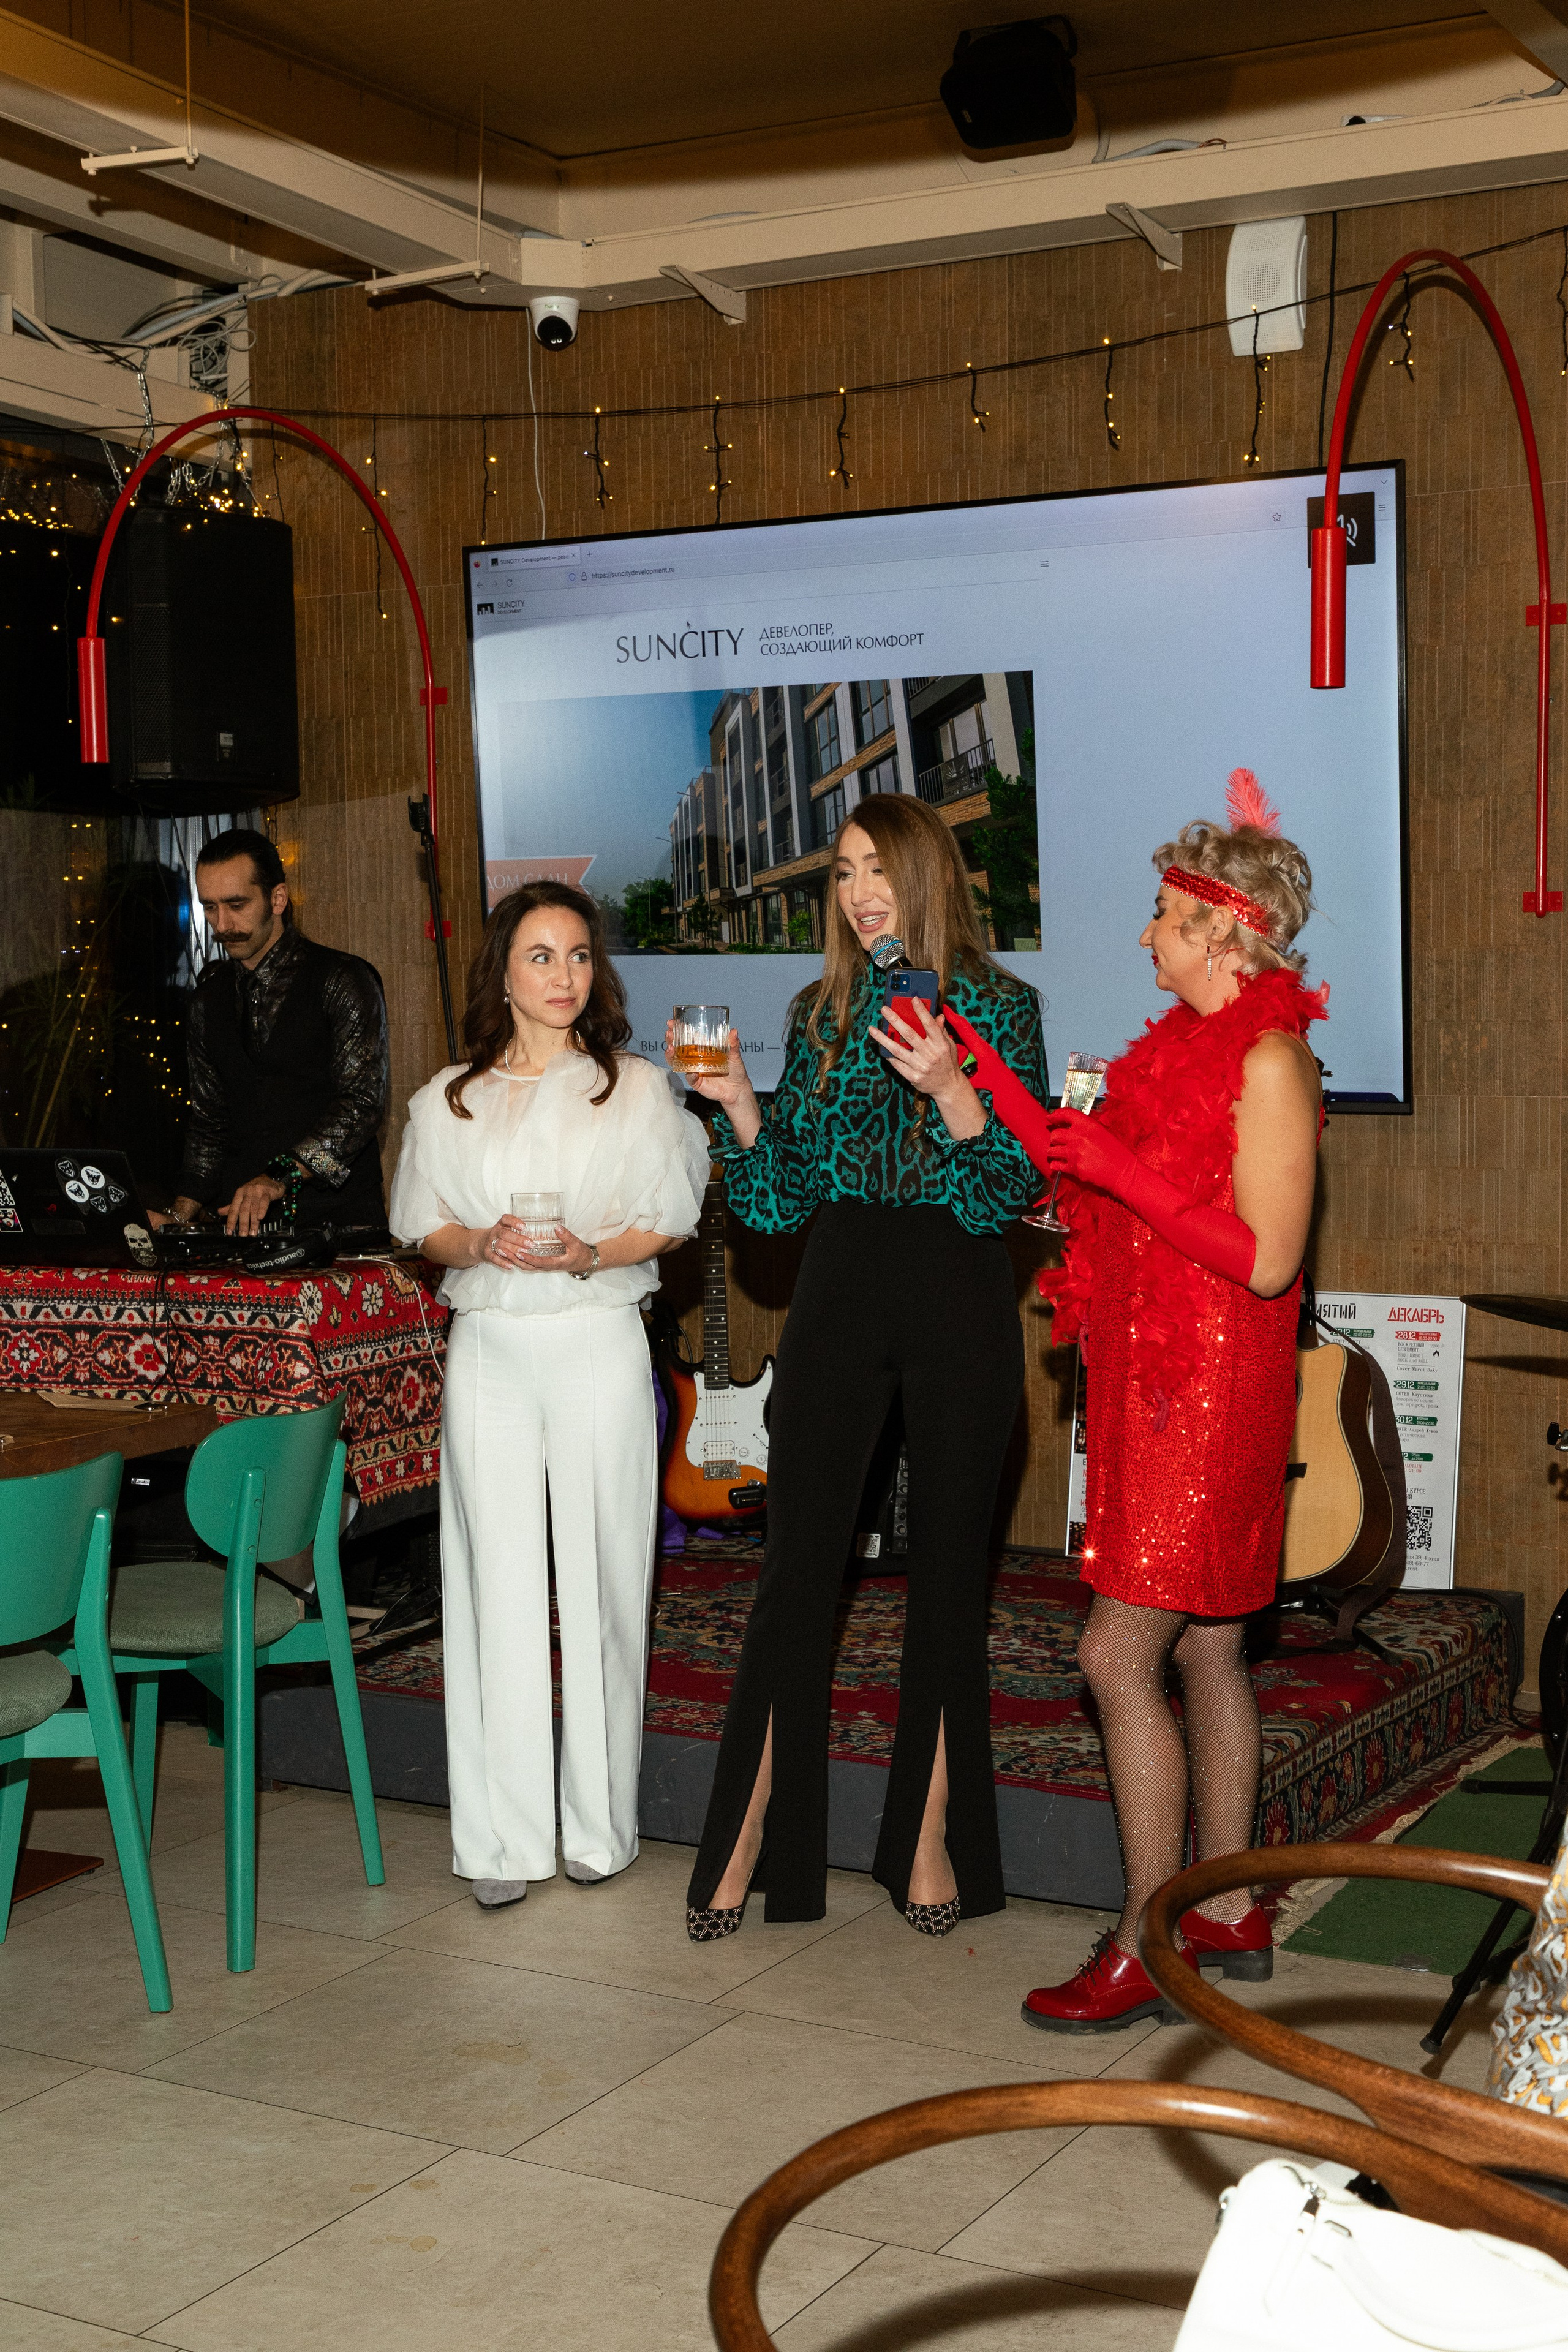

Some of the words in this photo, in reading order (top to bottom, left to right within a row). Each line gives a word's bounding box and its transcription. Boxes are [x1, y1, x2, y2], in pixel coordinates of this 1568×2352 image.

[592, 567, 675, 579] https://suncitydevelopment.ru
[497, 600, 525, 609] SUNCITY
[760, 622, 834, 641] ДЕВЕЛОПЕР,
[616, 628, 744, 663] SUNCITY
[760, 636, 852, 656] СОЗДАЮЩИЙ
[856, 633, 924, 649] КОМФОРТ
[641, 1041, 658, 1052] ВЫ
[1387, 1307, 1444, 1324] ДЕКАБРЬ
